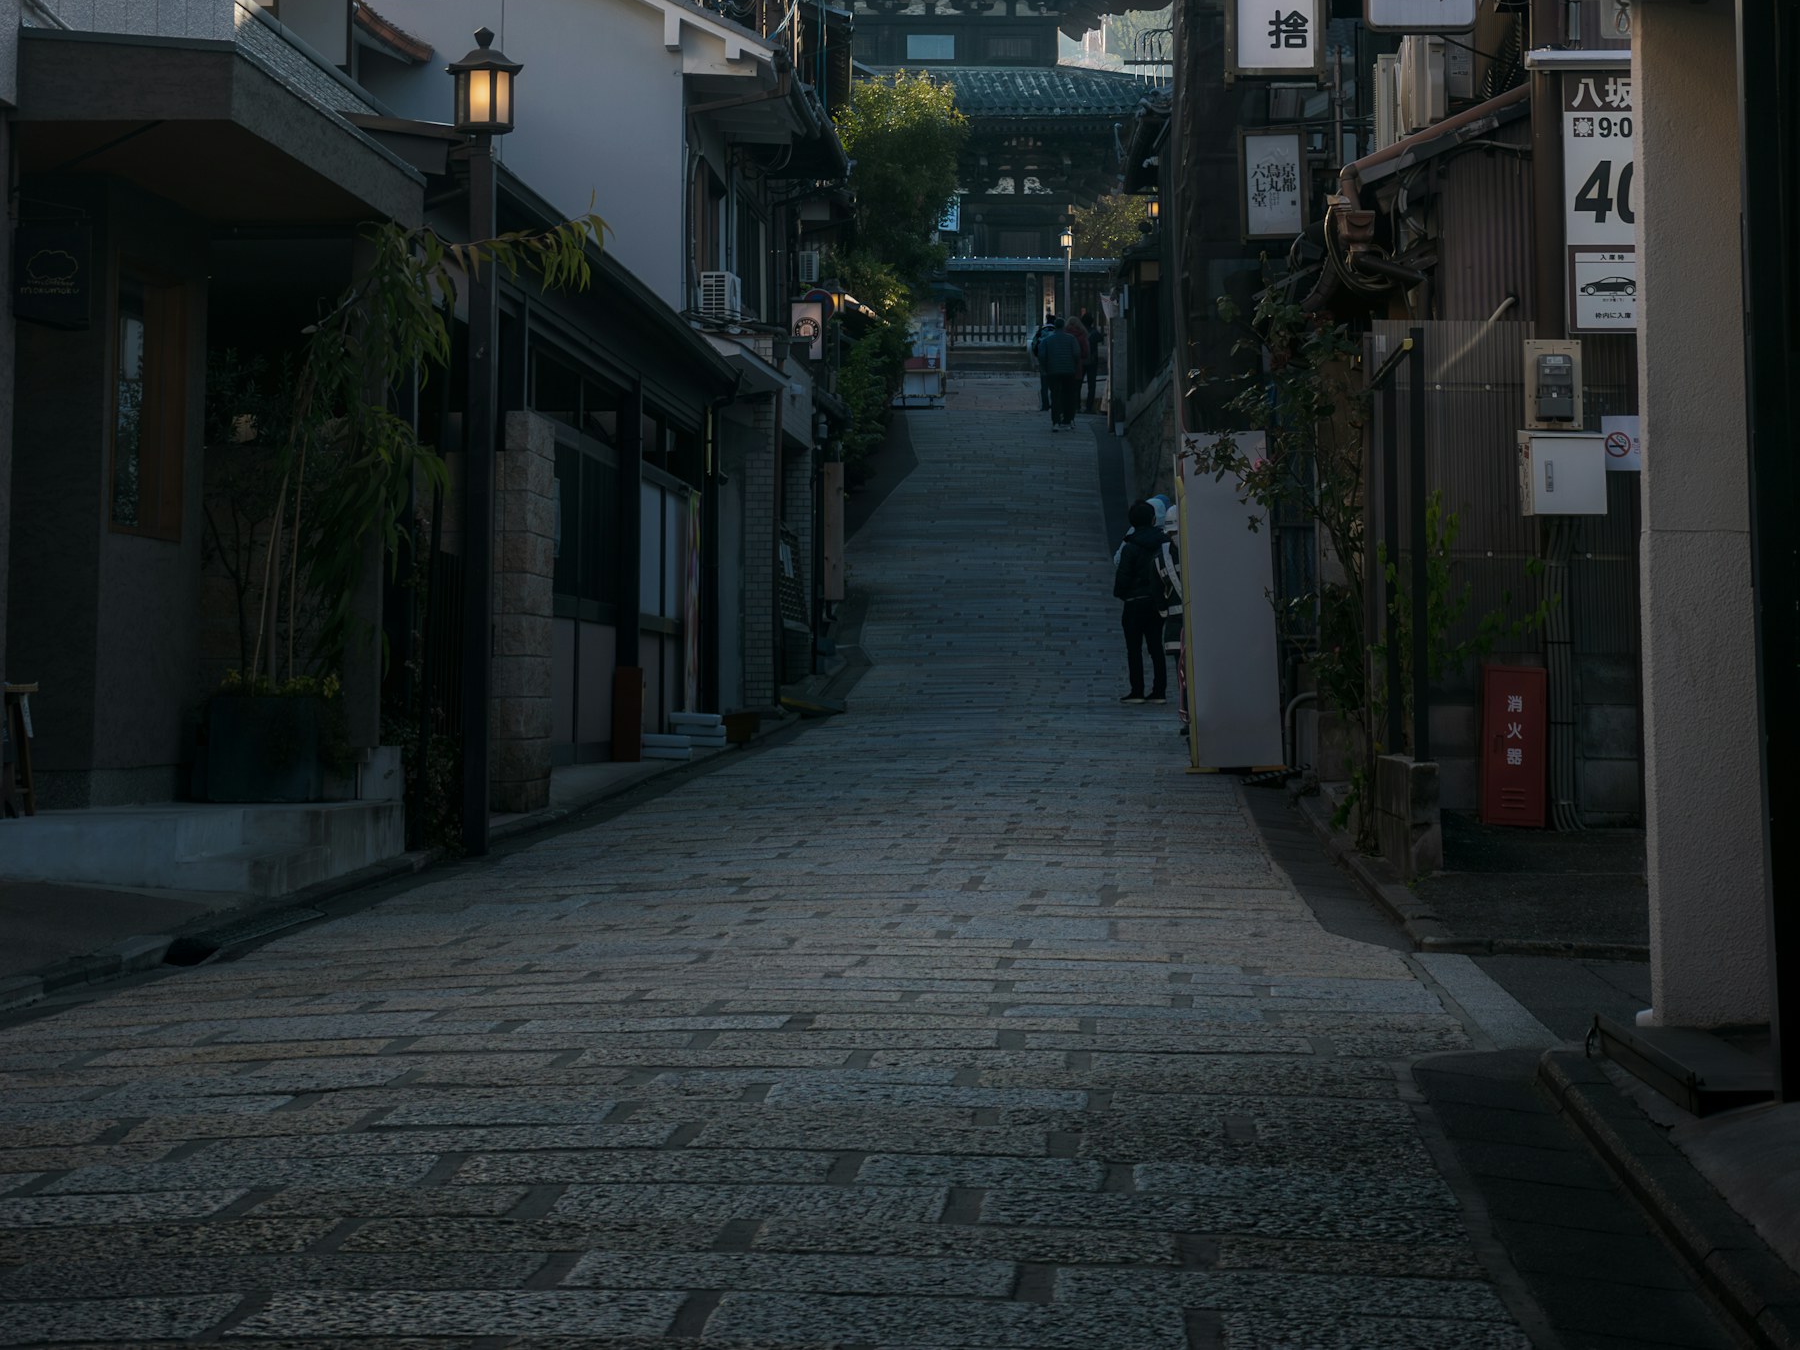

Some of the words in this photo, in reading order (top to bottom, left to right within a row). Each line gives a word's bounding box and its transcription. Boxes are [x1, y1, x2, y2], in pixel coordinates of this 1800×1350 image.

[1251, 163, 1267, 207] 六七堂
[1281, 163, 1296, 192] 京都
[1506, 694, 1523, 766] 消火器
